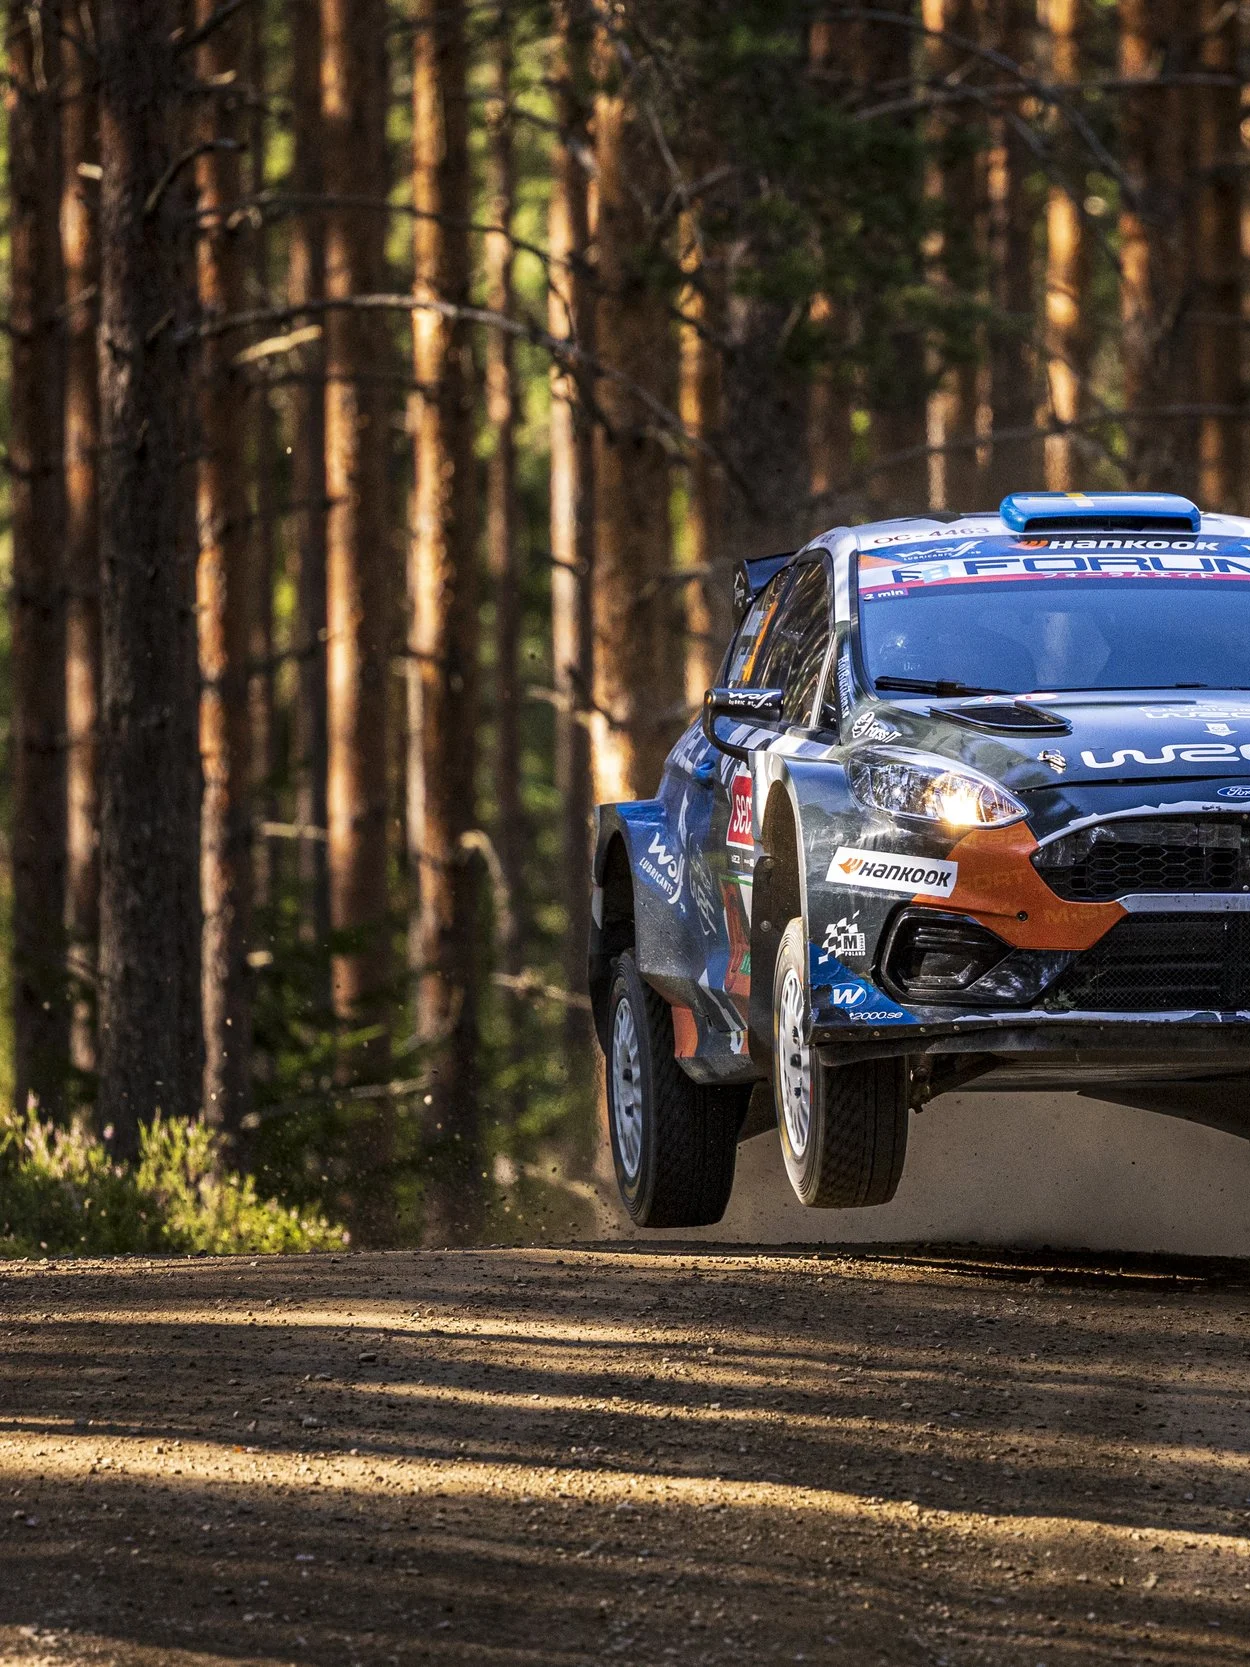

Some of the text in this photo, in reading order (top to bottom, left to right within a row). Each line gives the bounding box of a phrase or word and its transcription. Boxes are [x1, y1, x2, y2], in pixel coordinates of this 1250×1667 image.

[878, 589, 904, 597] min
[639, 857, 674, 895] LUBRICANTS
[833, 986, 864, 1004] W
